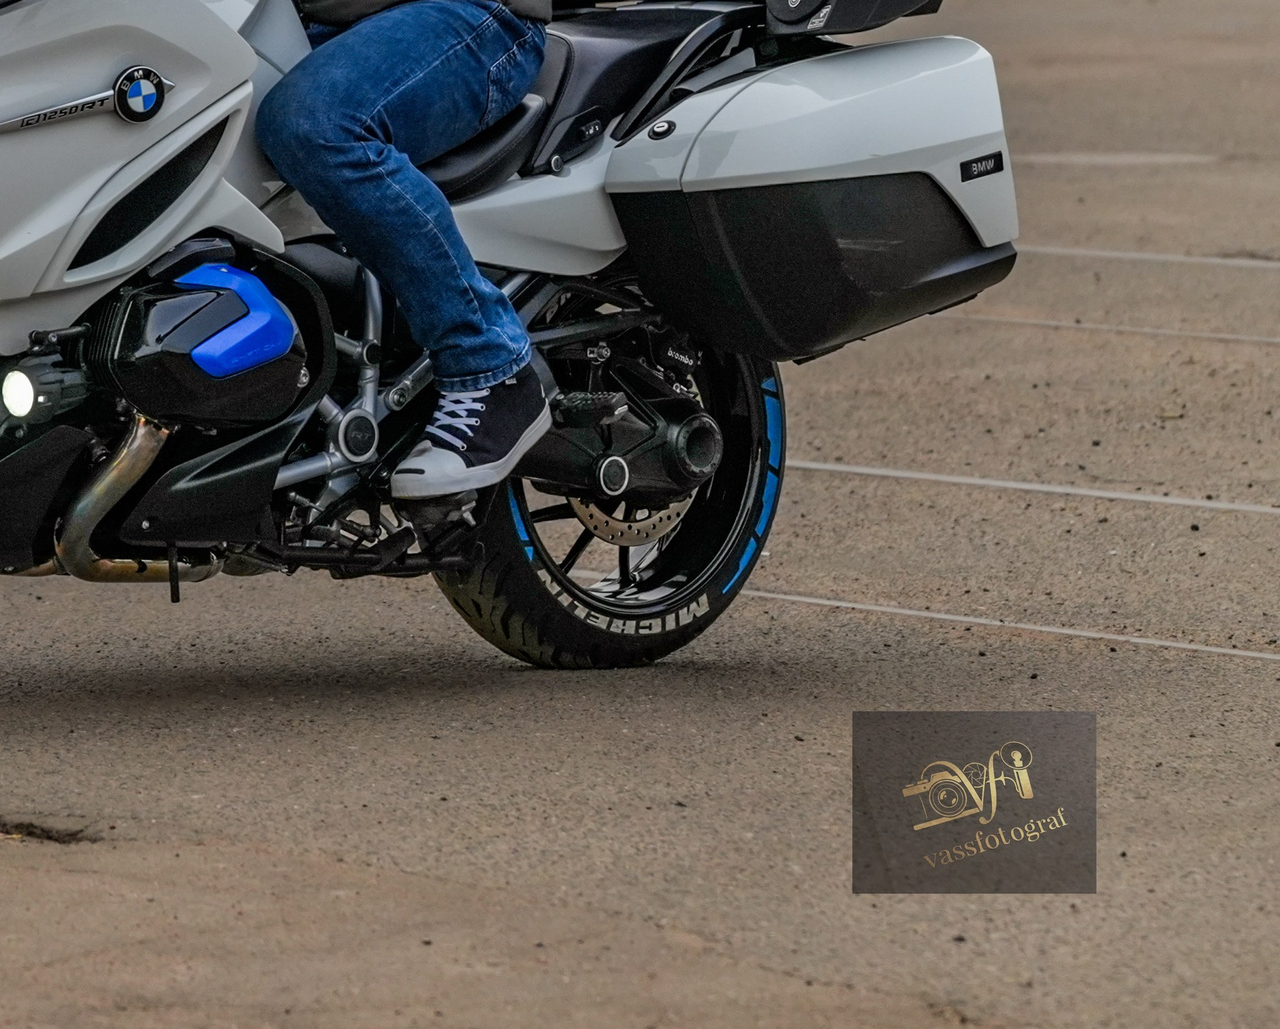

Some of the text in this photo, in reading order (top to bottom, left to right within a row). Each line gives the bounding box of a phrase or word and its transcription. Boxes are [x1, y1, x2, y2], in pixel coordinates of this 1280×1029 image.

[121, 69, 160, 91] BMW
[971, 158, 995, 175] BMW
[537, 569, 710, 635] MICHELIN
